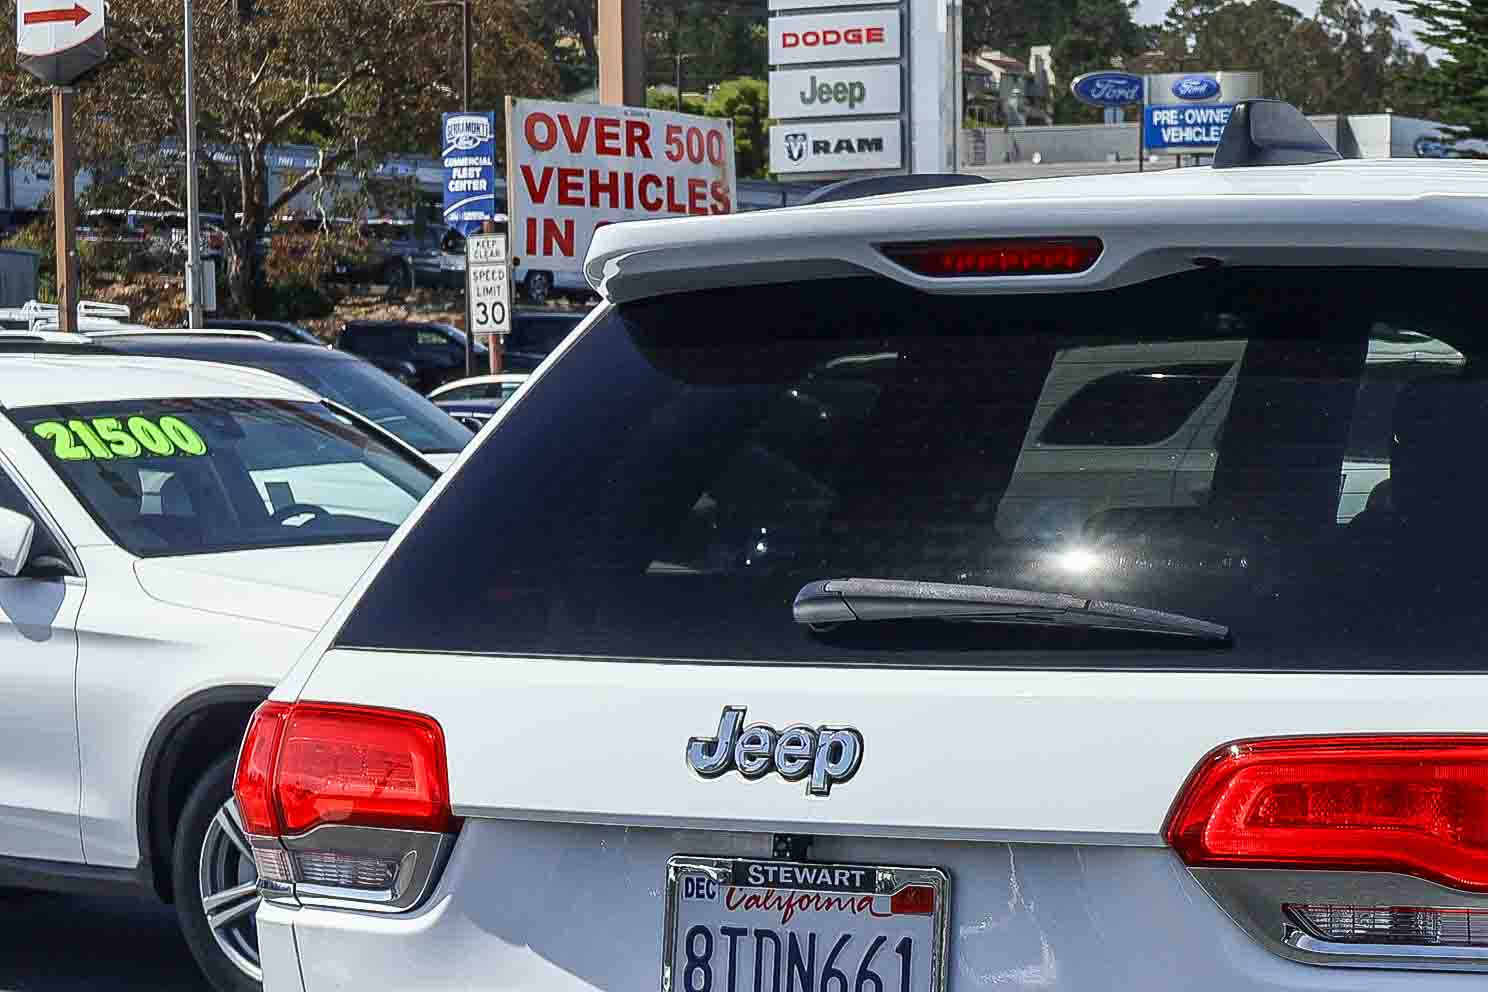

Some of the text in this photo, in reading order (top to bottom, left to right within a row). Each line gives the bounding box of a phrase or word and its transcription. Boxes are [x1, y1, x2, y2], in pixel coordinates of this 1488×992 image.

[782, 27, 885, 48] DODGE
[800, 75, 866, 110] Jeep
[1090, 79, 1139, 100] Ford
[1179, 79, 1208, 95] Ford
[1152, 109, 1232, 125] PRE-OWNE
[524, 111, 726, 168] OVER 500
[812, 137, 884, 155] RAM
[448, 180, 488, 192] CENTER
[520, 164, 731, 215] VEHICLES
[475, 239, 497, 249] KEEP
[526, 217, 575, 257] IN
[472, 268, 505, 282] SPEED
[476, 286, 502, 297] LIMIT
[476, 302, 506, 325] 30
[33, 415, 208, 461] 21500
[687, 704, 865, 797] Jeep
[684, 876, 718, 900] DEC
[748, 864, 866, 889] STEWART
[726, 886, 892, 924] California
